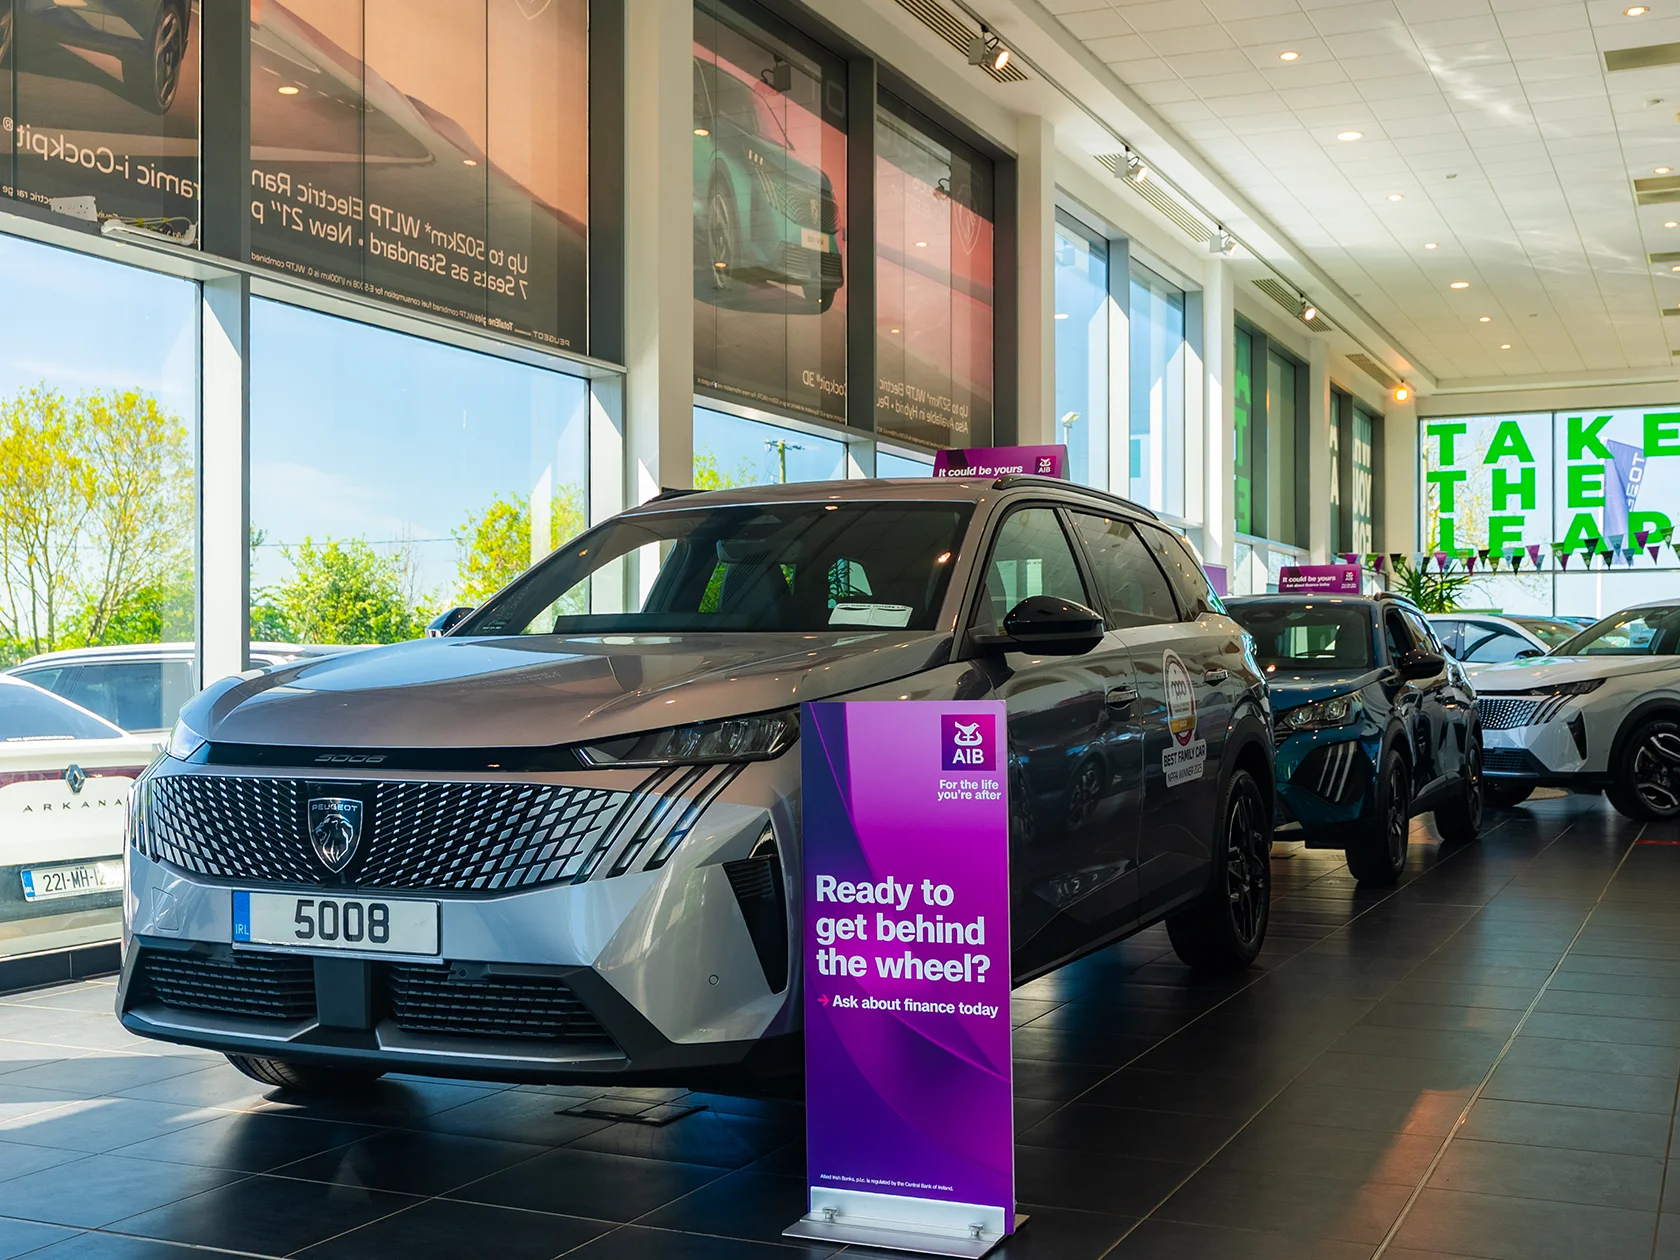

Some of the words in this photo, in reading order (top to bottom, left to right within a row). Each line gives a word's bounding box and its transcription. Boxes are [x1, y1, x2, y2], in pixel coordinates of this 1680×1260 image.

[1427, 412, 1680, 466] TAKE
[938, 468, 946, 477] It
[947, 466, 976, 477] could
[978, 465, 991, 475] be
[993, 465, 1023, 477] yours
[1427, 464, 1605, 513] THE
[1440, 511, 1672, 558] LEAP
[1317, 575, 1336, 583] yours
[952, 748, 985, 764] AIB
[1163, 752, 1177, 767] BEST
[1177, 748, 1195, 763] FAMILY
[1195, 744, 1206, 758] CAR
[937, 789, 973, 802] you're
[975, 789, 1001, 800] after
[939, 779, 958, 790] For
[960, 779, 979, 790] the
[981, 779, 999, 790] life
[23, 798, 123, 812] ARKANA
[311, 803, 358, 812] PEUGEOT
[816, 874, 914, 911] Ready
[921, 879, 954, 907] to
[235, 923, 249, 935] IRL
[294, 898, 390, 944] 5008
[816, 914, 867, 945] get
[876, 912, 985, 945] behind
[816, 947, 867, 978] the
[874, 950, 991, 983] wheel?
[832, 994, 859, 1009] Ask
[861, 996, 901, 1011] about
[903, 998, 955, 1014] finance
[958, 1001, 999, 1019] today
